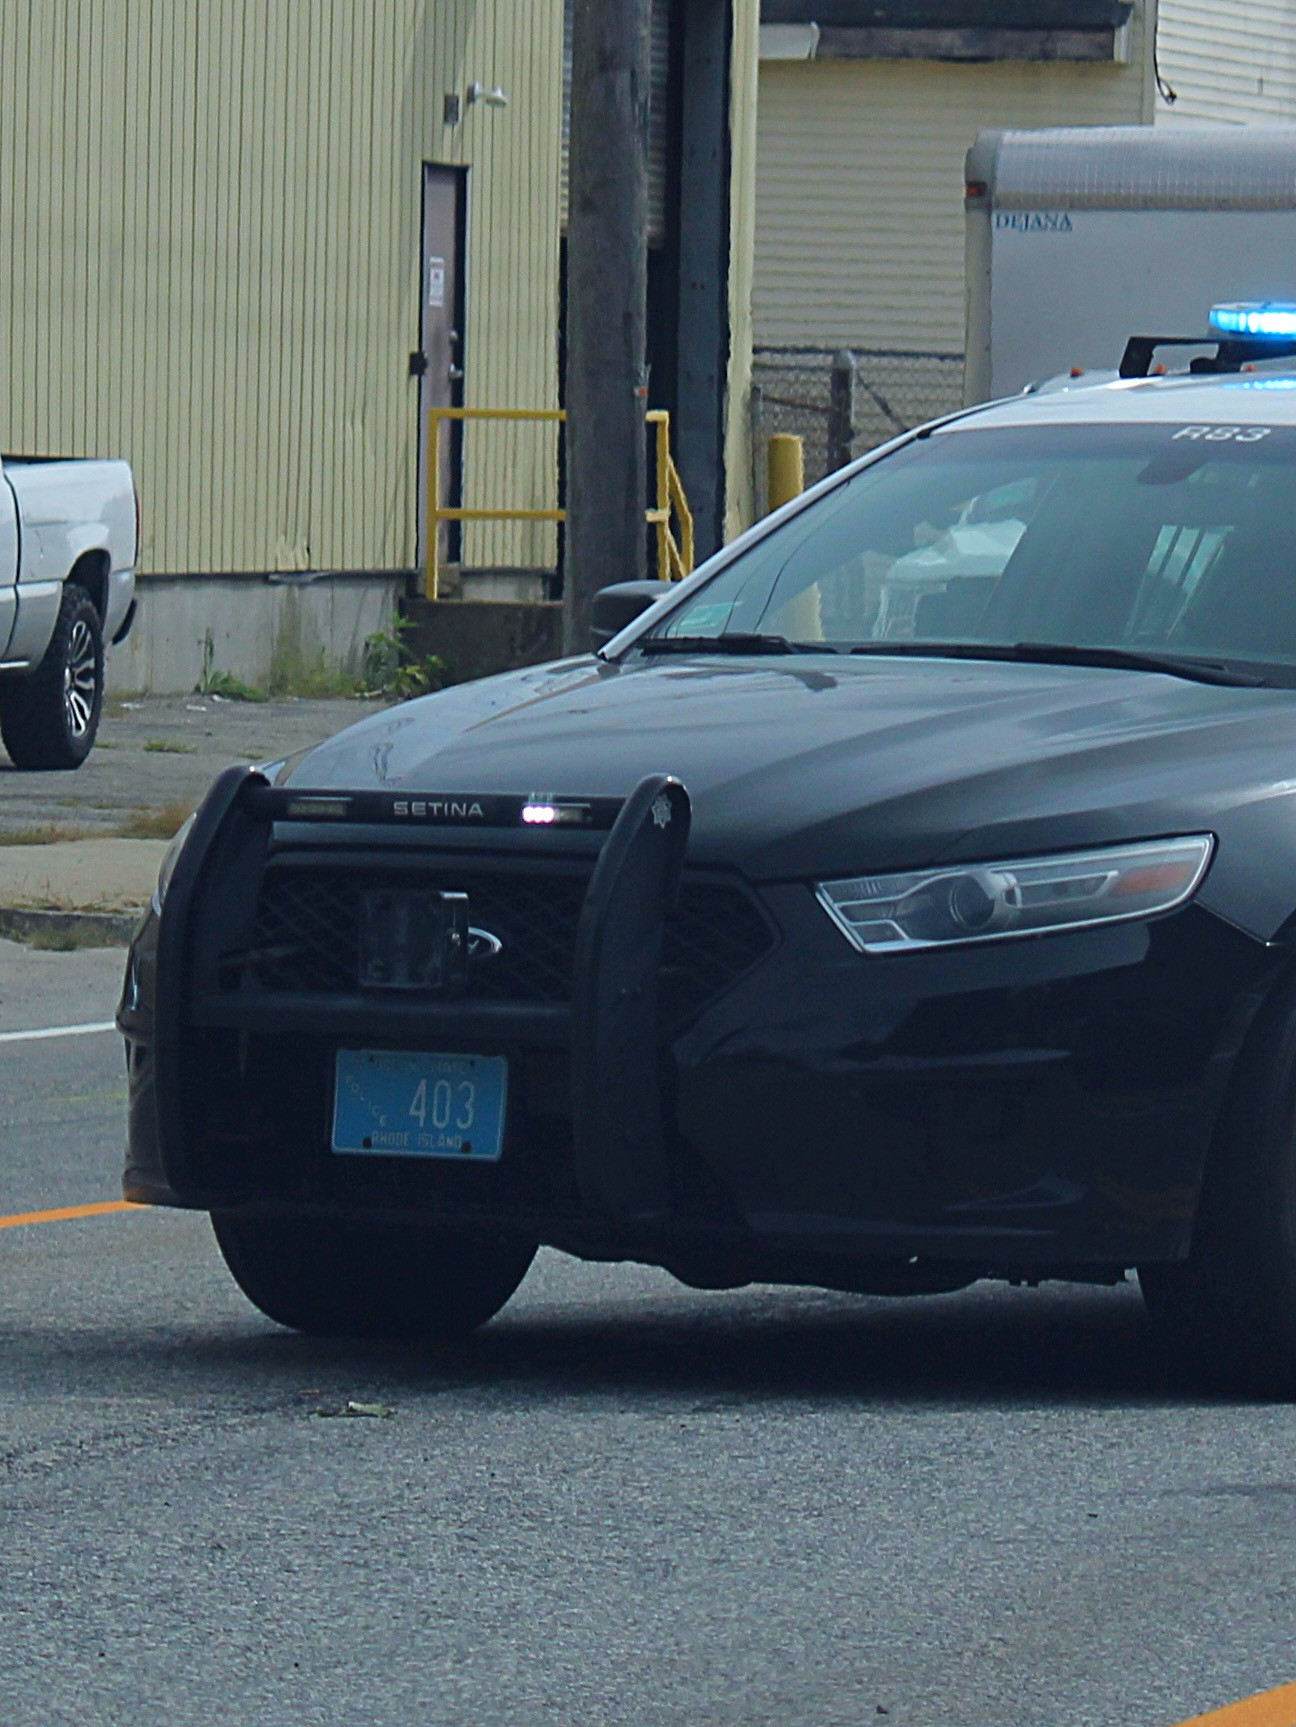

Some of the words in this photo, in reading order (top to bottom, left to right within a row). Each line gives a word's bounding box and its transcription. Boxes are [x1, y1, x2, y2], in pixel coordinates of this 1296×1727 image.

[995, 212, 1074, 232] DEJANA
[1171, 424, 1273, 443] R83
[392, 800, 485, 818] SETINA
[408, 1077, 476, 1130] 403
[371, 1130, 411, 1148] RHODE
[417, 1131, 464, 1150] ISLAND
